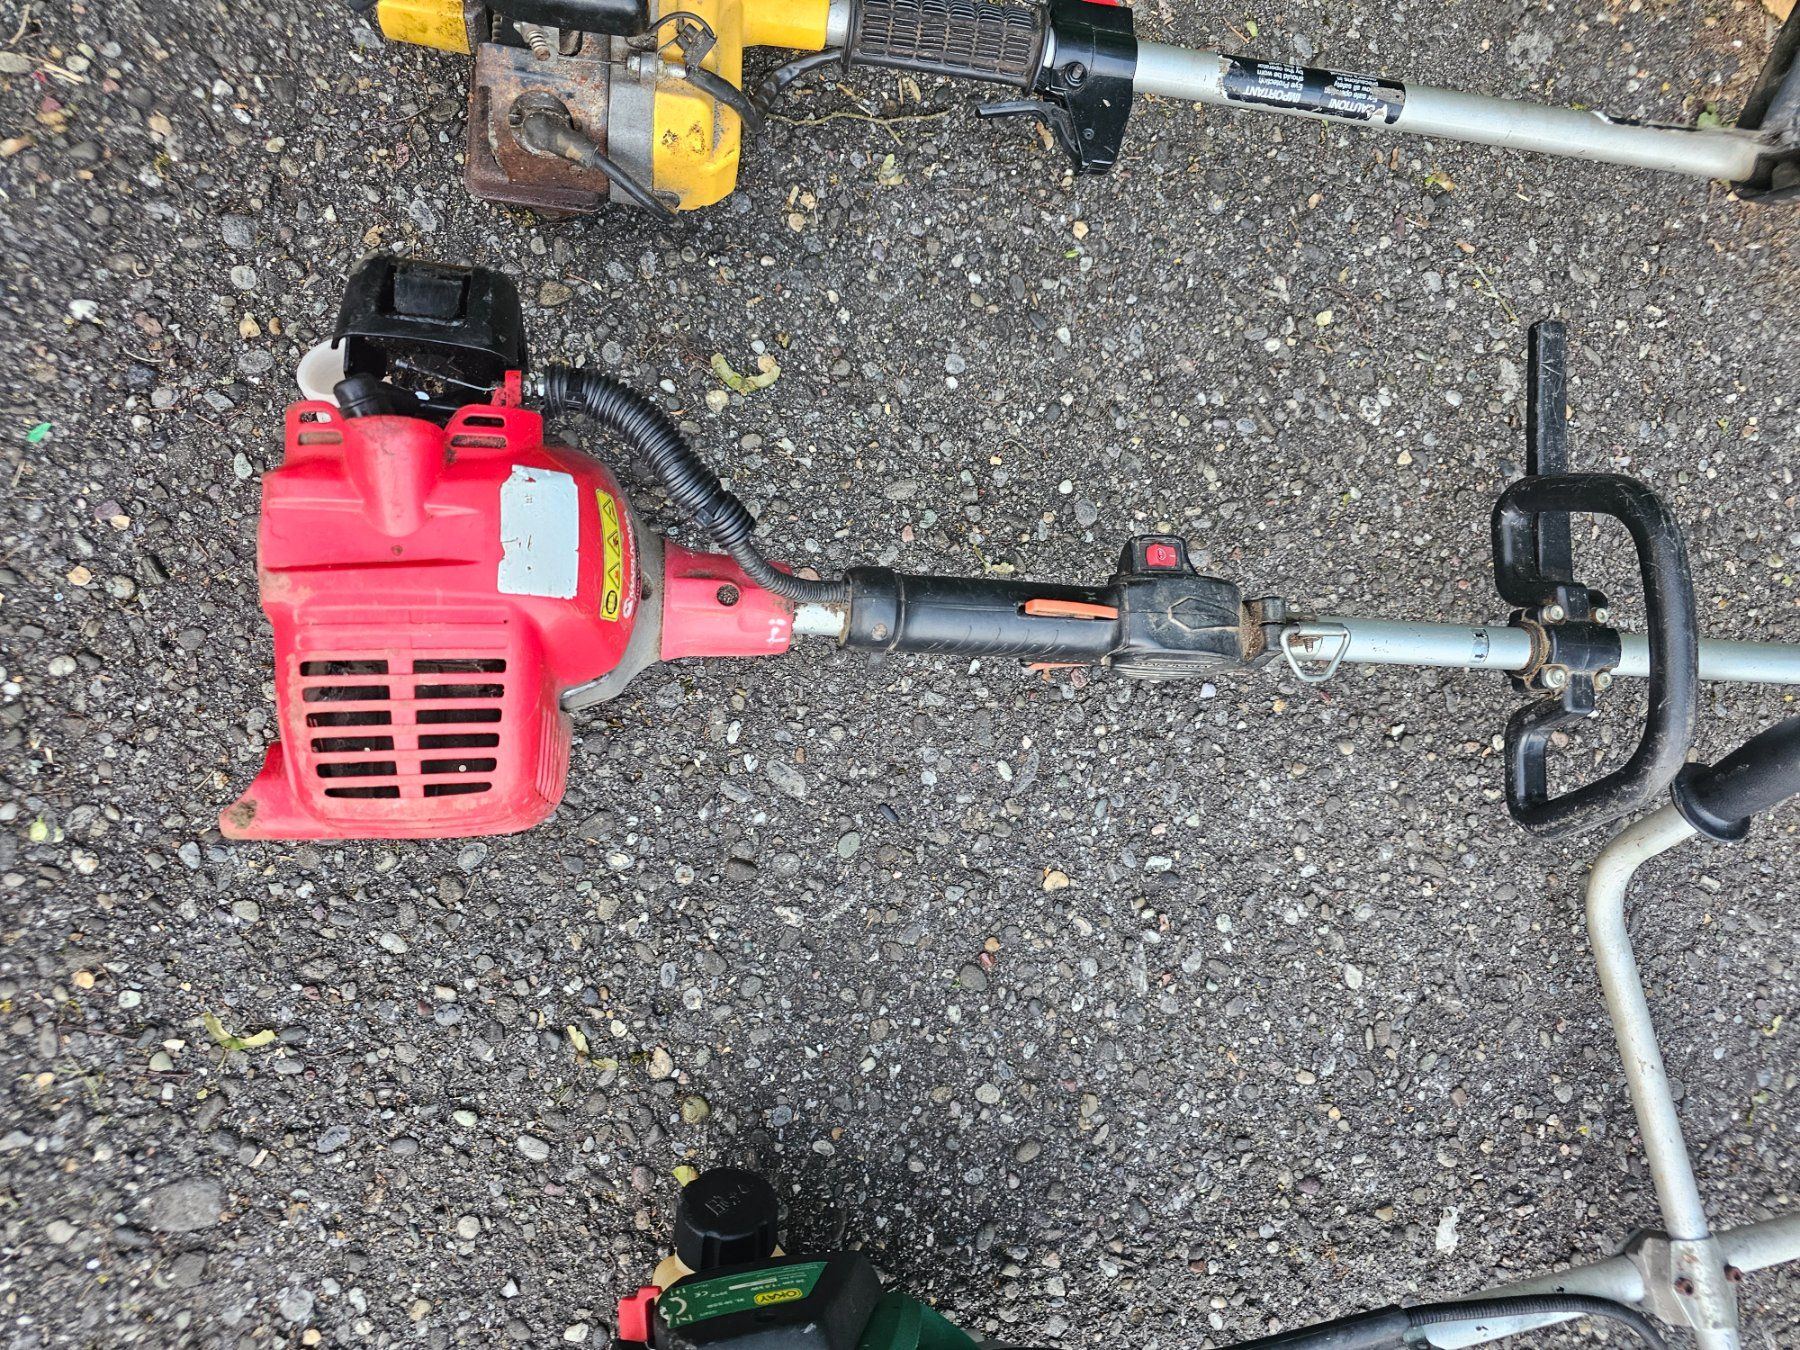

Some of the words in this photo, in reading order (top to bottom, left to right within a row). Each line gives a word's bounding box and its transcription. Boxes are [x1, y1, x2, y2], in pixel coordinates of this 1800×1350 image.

[1256, 69, 1273, 77] worn
[1283, 66, 1294, 74] the
[1295, 66, 1304, 75] by
[1273, 71, 1283, 79] be
[1283, 73, 1304, 82] should
[1290, 80, 1303, 91] Eye
[1242, 85, 1301, 103] IMPORTANT
[760, 1290, 797, 1302] OKAY
